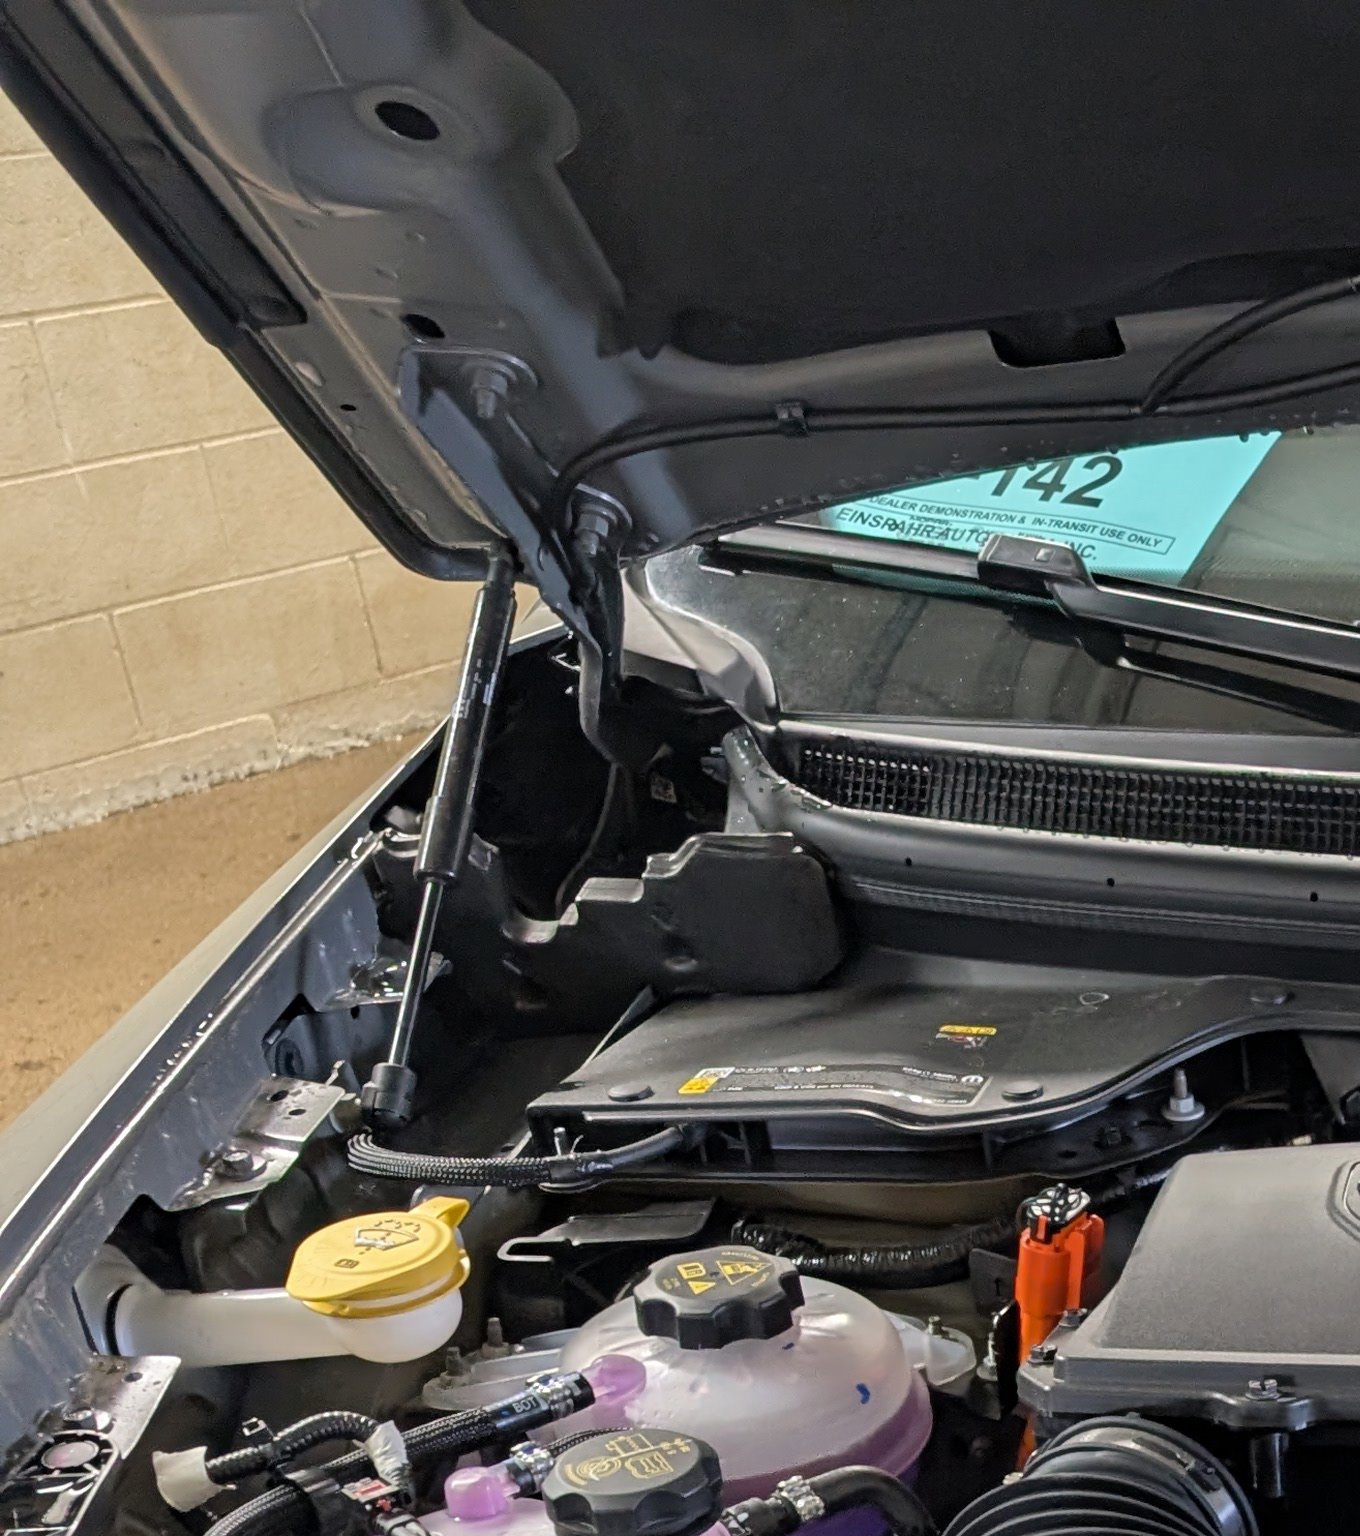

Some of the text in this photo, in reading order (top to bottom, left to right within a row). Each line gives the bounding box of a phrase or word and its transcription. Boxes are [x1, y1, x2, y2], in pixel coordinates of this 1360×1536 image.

[869, 496, 917, 512] DEALER
[919, 503, 1016, 524] DEMONSTRATION
[1017, 516, 1027, 525] &
[1031, 516, 1098, 535] IN-TRANSIT
[1100, 526, 1124, 541] USE
[1127, 532, 1163, 548] ONLY
[1064, 540, 1097, 561] NC.
[512, 1395, 537, 1414] BOT
